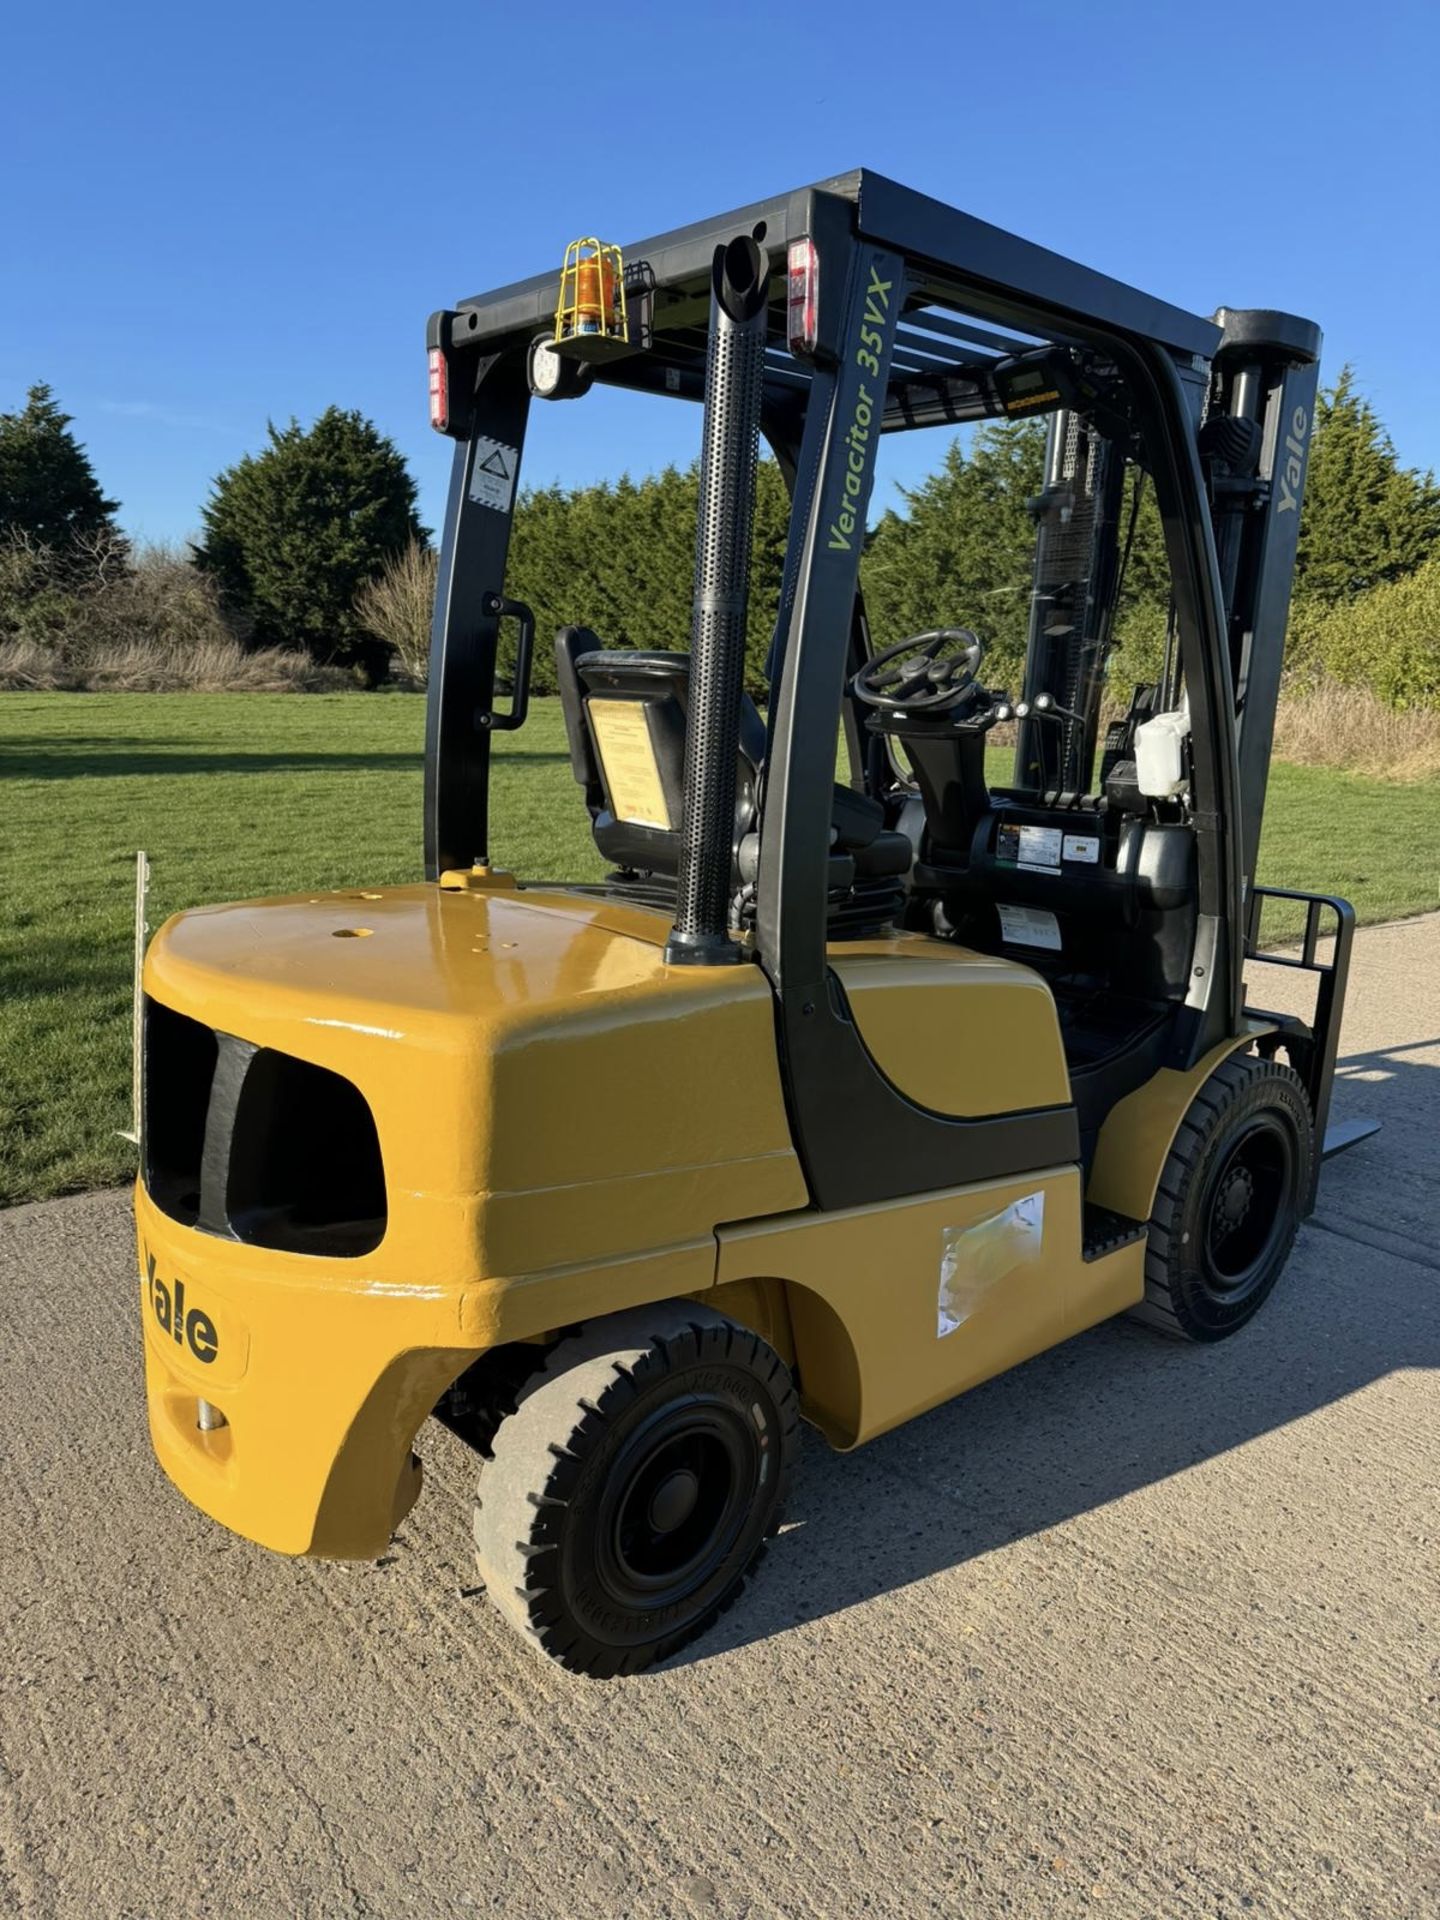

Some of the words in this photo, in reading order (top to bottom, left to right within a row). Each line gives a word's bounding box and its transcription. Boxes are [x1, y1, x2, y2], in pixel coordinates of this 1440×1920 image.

[828, 383, 874, 550] Veracitor
[857, 265, 892, 378] 35VX
[1277, 405, 1307, 513] Yale
[144, 1238, 218, 1364] Yale
